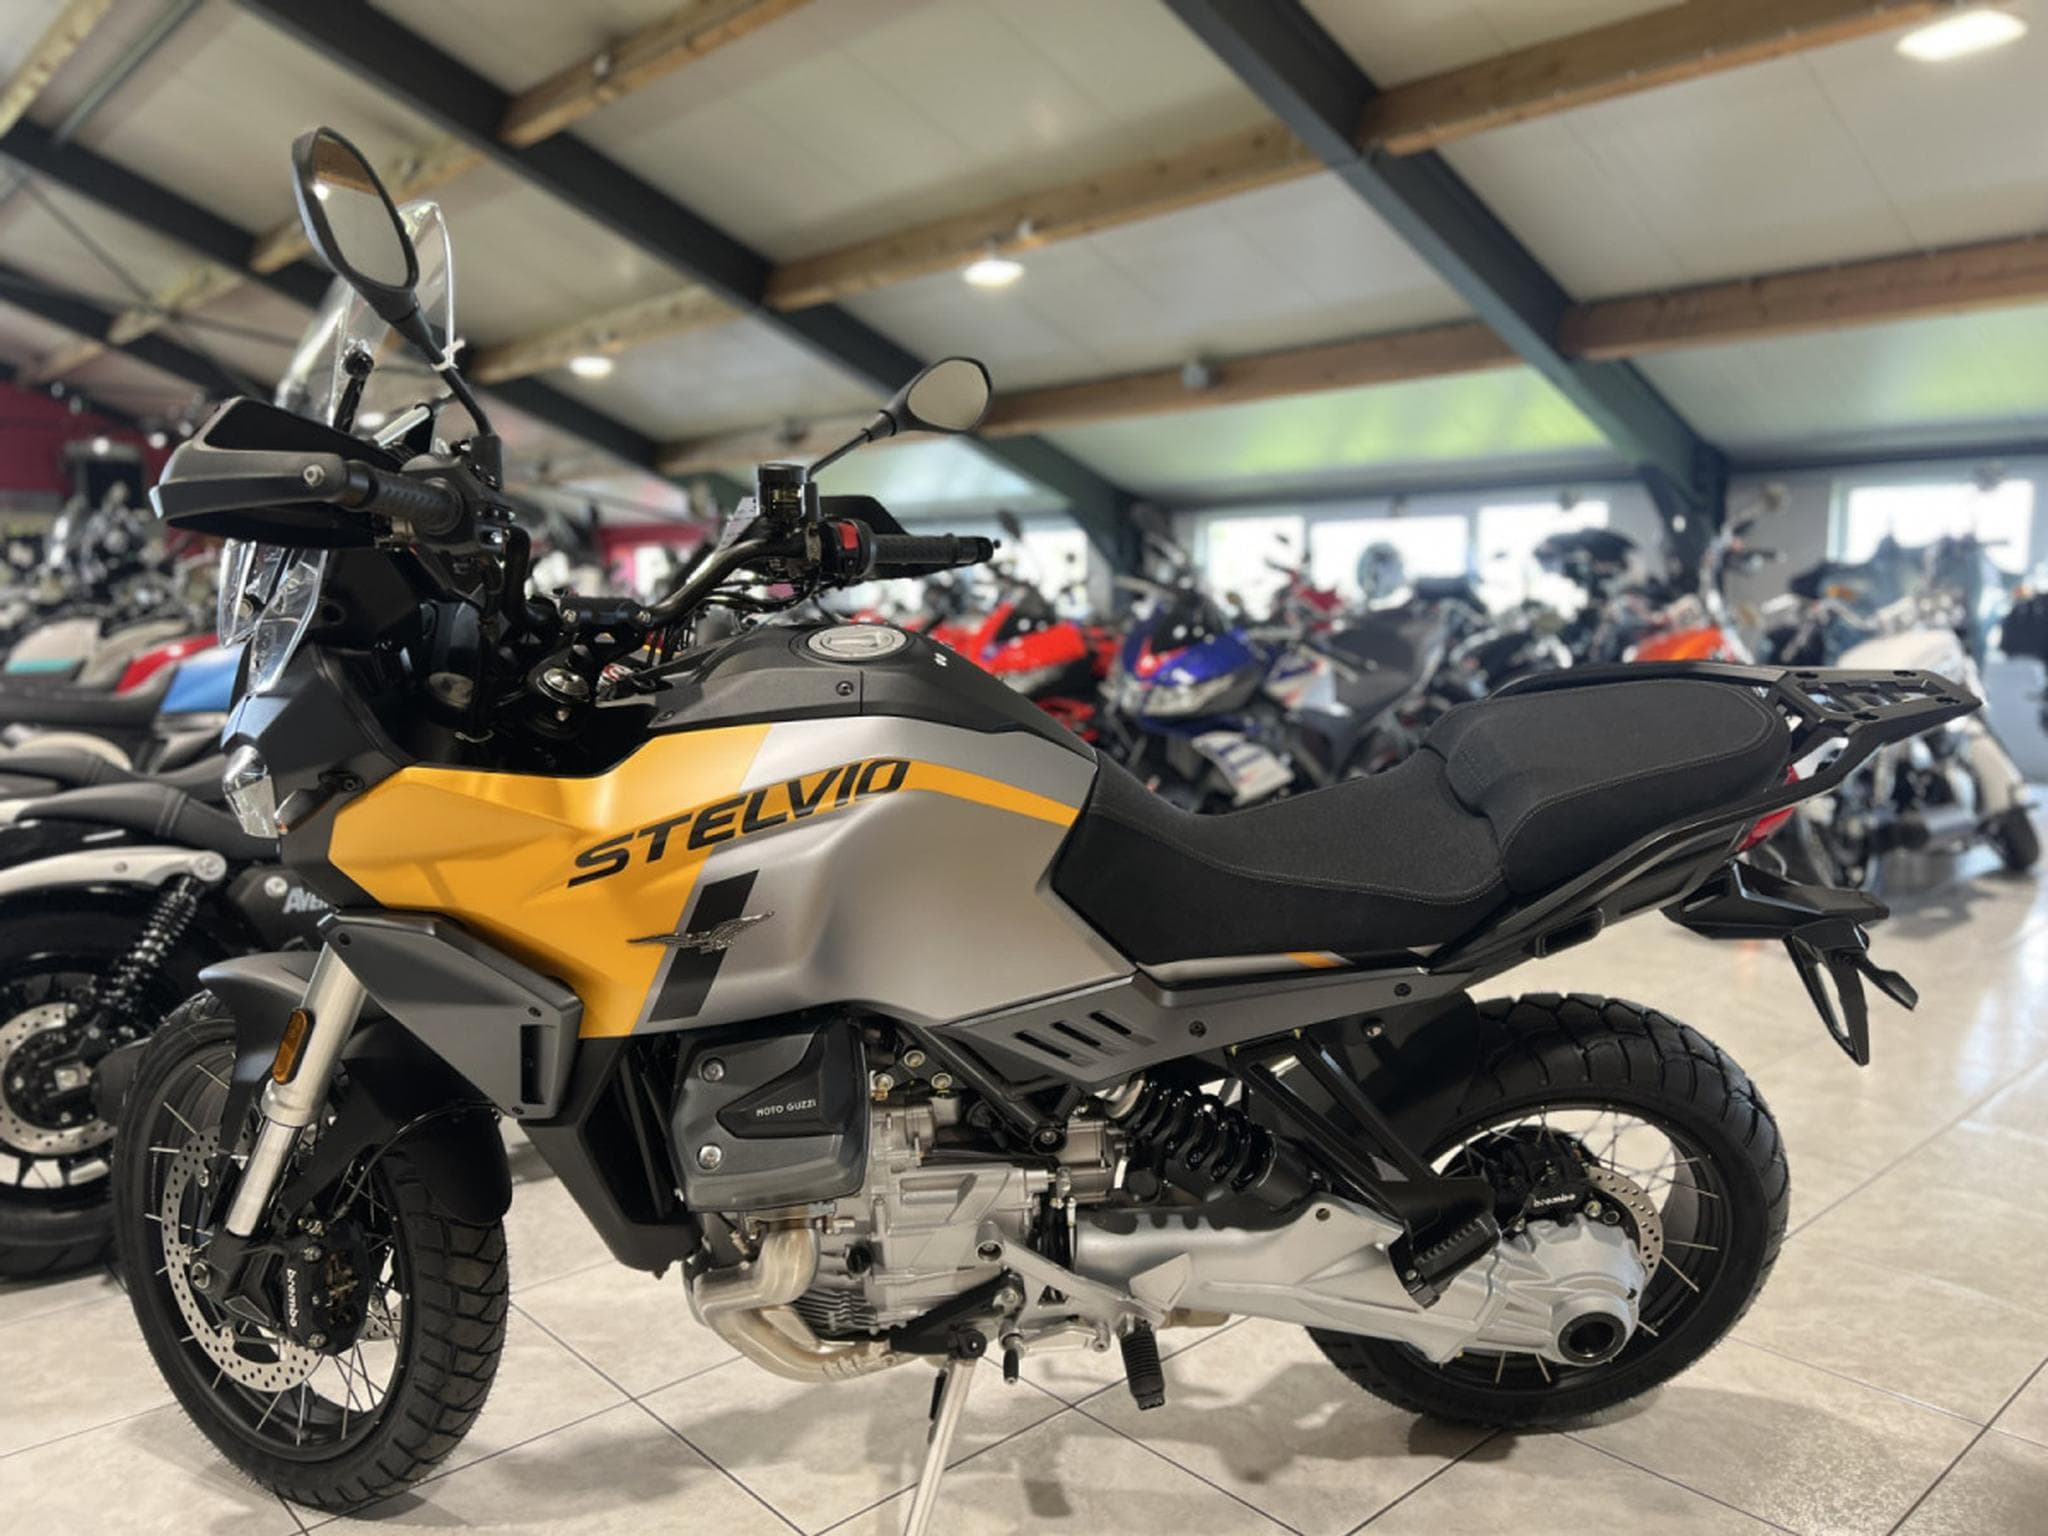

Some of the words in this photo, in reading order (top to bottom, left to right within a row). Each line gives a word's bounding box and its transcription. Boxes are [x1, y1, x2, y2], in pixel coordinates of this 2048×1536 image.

[567, 759, 911, 888] STELVIO
[756, 1105, 784, 1117] MOTO
[786, 1099, 816, 1111] GUZZI
[1533, 1193, 1576, 1207] brembo
[286, 1268, 299, 1327] brembo
